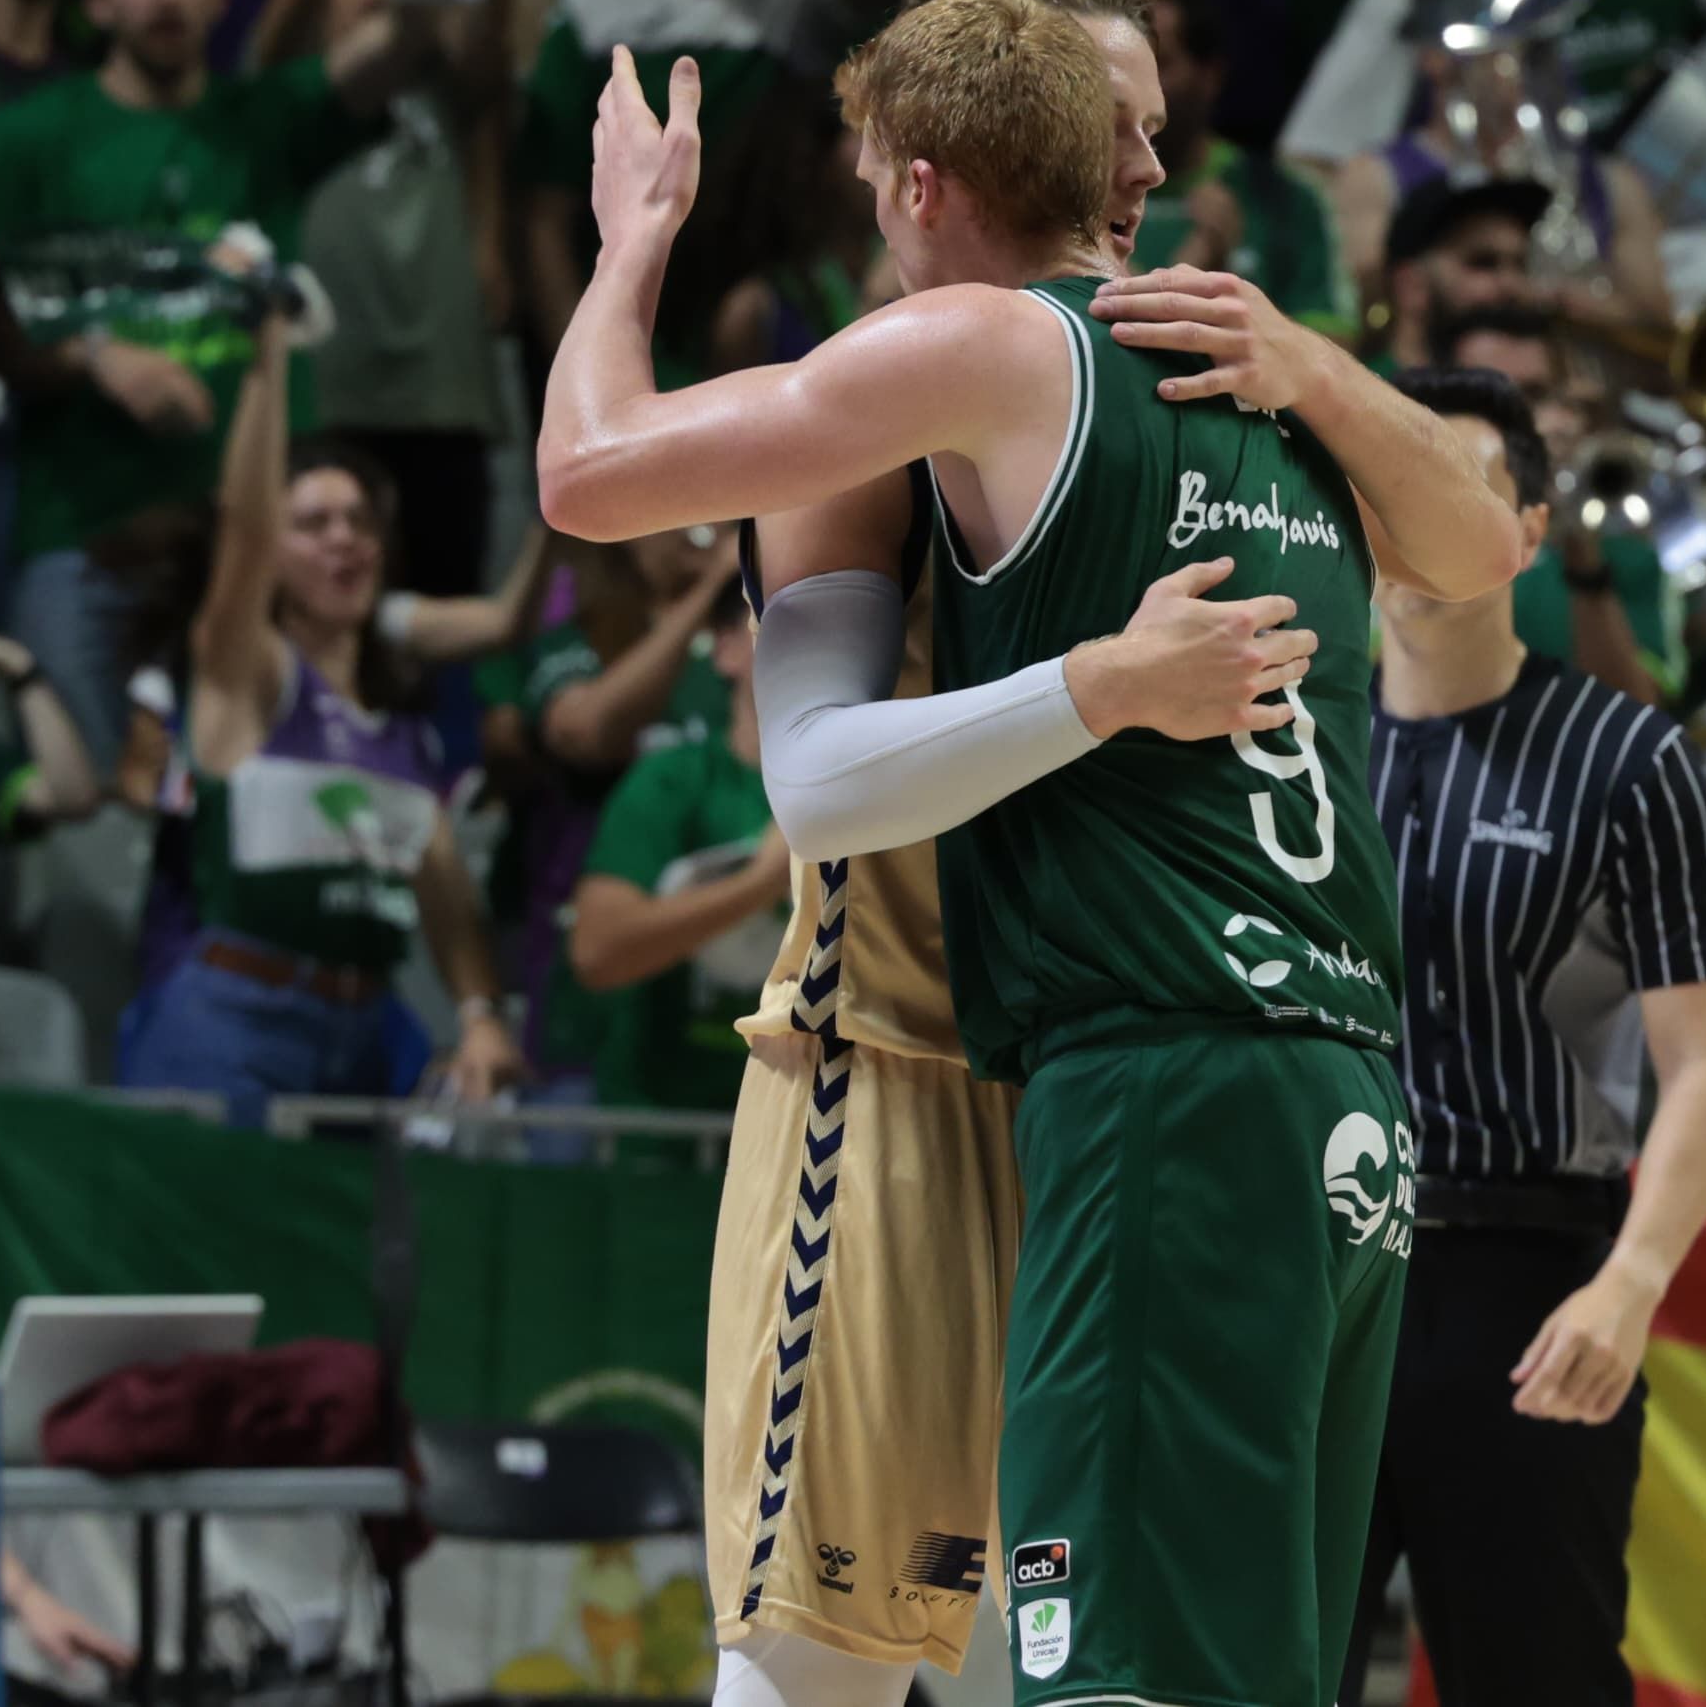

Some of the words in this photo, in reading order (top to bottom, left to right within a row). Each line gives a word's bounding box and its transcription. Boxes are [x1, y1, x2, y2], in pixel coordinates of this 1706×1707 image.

[1230, 679, 1336, 883] 9
[1018, 1558, 1055, 1581] acb
[1027, 1634, 1064, 1649] Fundación
[1032, 1646, 1059, 1659] Unicaja
